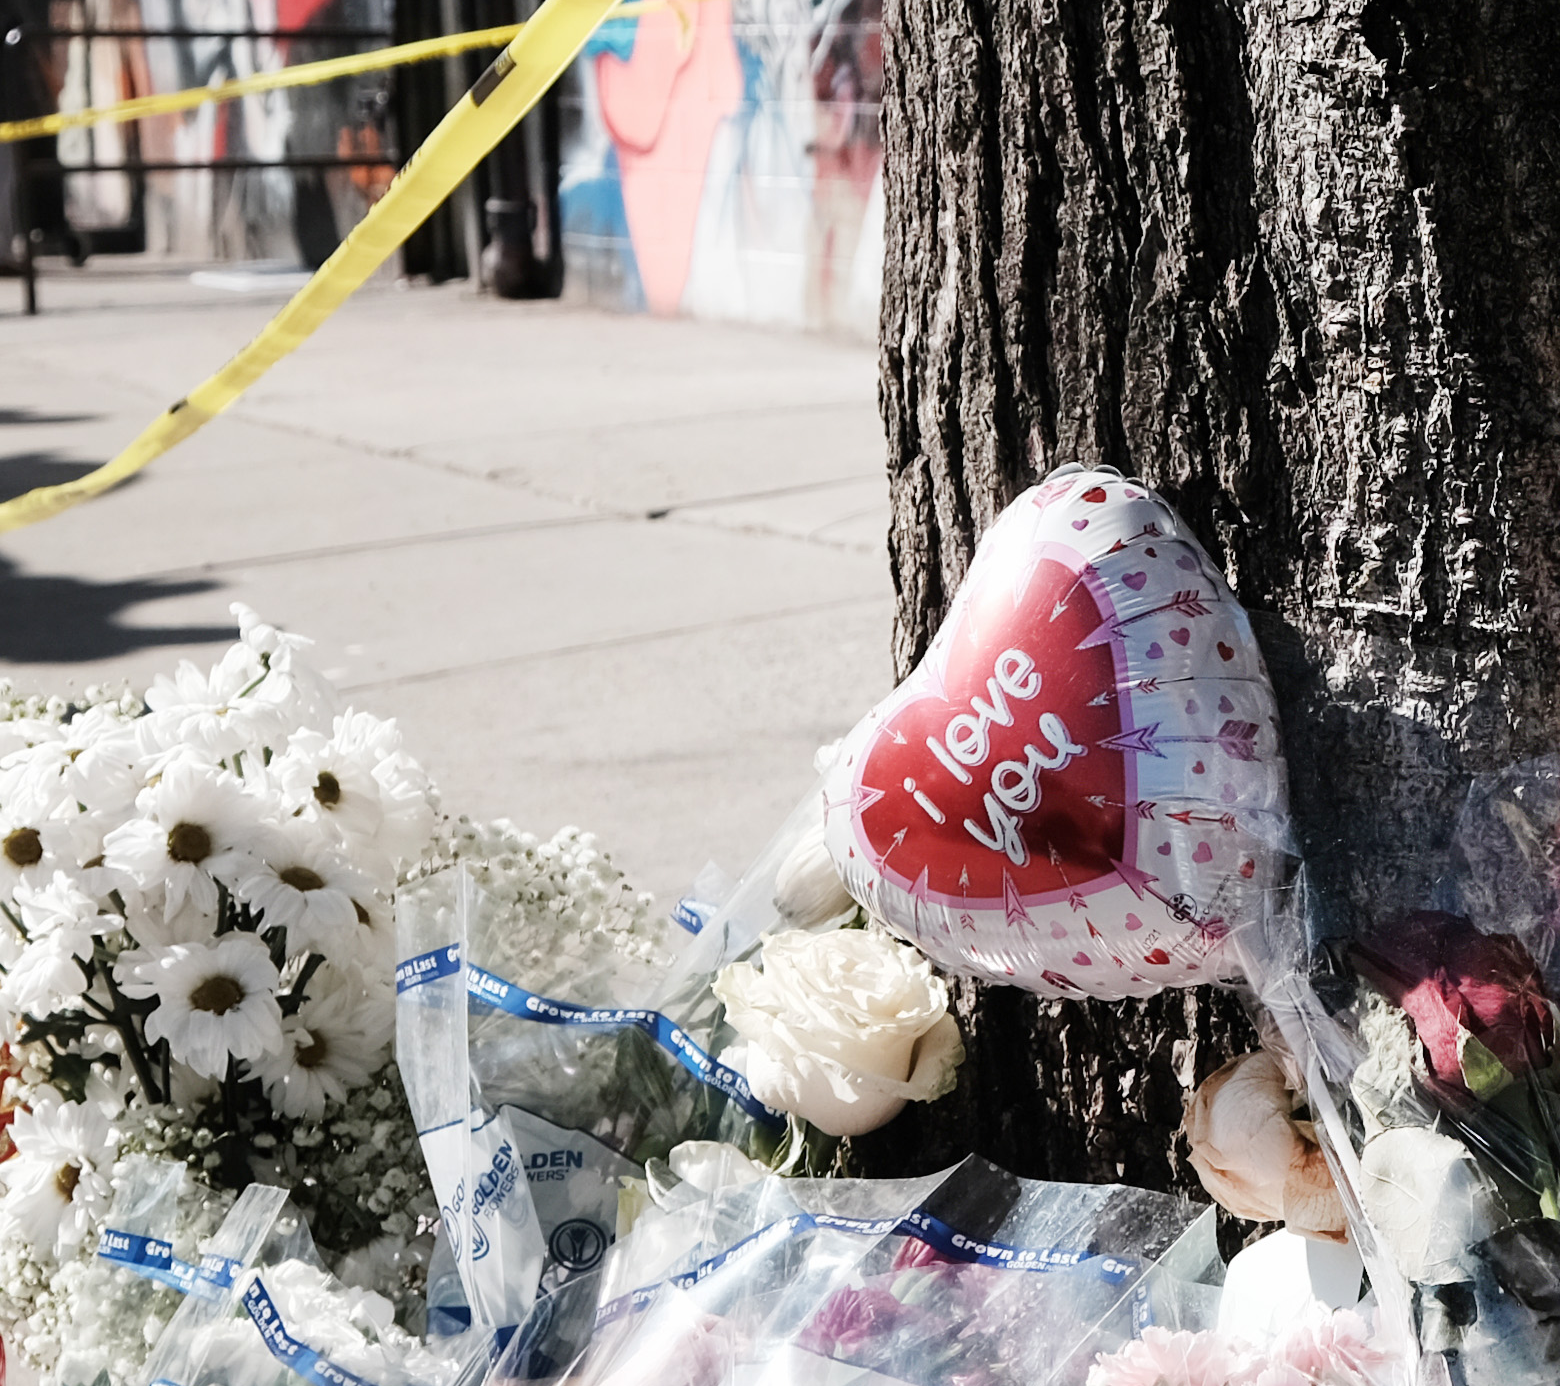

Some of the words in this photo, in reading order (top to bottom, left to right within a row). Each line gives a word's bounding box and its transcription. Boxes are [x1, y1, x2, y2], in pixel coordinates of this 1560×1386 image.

[903, 776, 946, 825] i
[926, 648, 1042, 786] love
[963, 712, 1088, 868] you
[671, 1029, 712, 1072] Grown
[715, 1062, 733, 1083] to
[472, 1139, 514, 1216] GOLDEN
[521, 1151, 582, 1169] LDEN
[524, 1169, 566, 1182] WERS
[145, 1241, 171, 1258] Gro
[951, 1233, 1020, 1261] Grown
[1025, 1247, 1038, 1261] to
[1040, 1248, 1080, 1267] Last
[258, 1296, 273, 1324] to
[268, 1319, 299, 1355] Last
